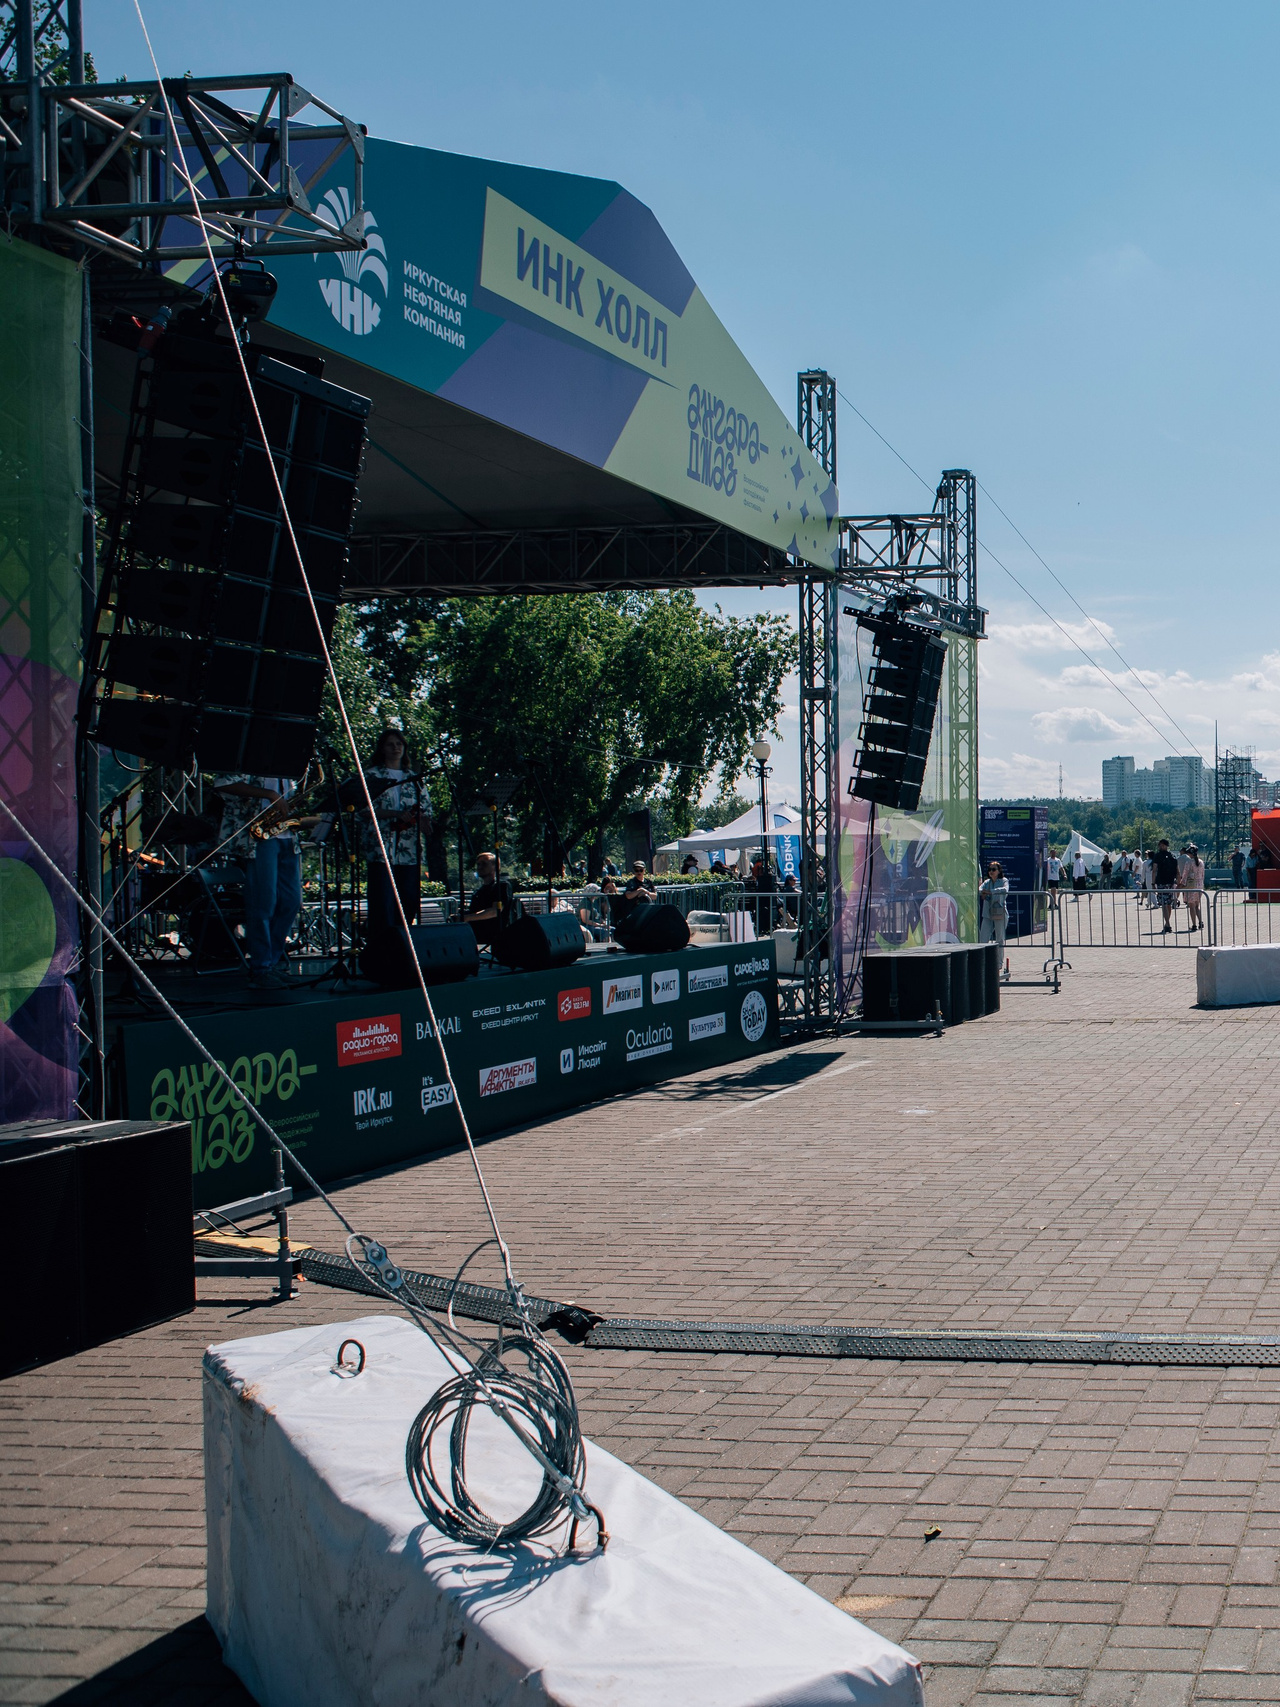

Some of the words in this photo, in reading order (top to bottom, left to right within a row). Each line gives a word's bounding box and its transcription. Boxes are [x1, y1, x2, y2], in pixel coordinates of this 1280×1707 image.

[403, 260, 467, 308] ИРКУТСКАЯ
[403, 282, 462, 327] НЕФТЯНАЯ
[517, 226, 585, 318] ИНК
[595, 278, 668, 368] ХОЛЛ
[318, 278, 381, 336] ИНК
[403, 305, 465, 350] КОМПАНИЯ
[661, 979, 676, 993] АИСТ
[472, 1006, 501, 1018] EXEED
[506, 999, 546, 1011] EXLANTIX
[481, 1020, 501, 1030] EXEED
[691, 1020, 717, 1035] Культура
[626, 1022, 673, 1050] Ocularia
[578, 1040, 607, 1056] Инсайт
[577, 1056, 601, 1070] Люди
[422, 1076, 434, 1086] It's
[423, 1086, 452, 1106] EASY
[355, 1120, 370, 1131] Твой
[370, 1115, 394, 1128] Иркутск
